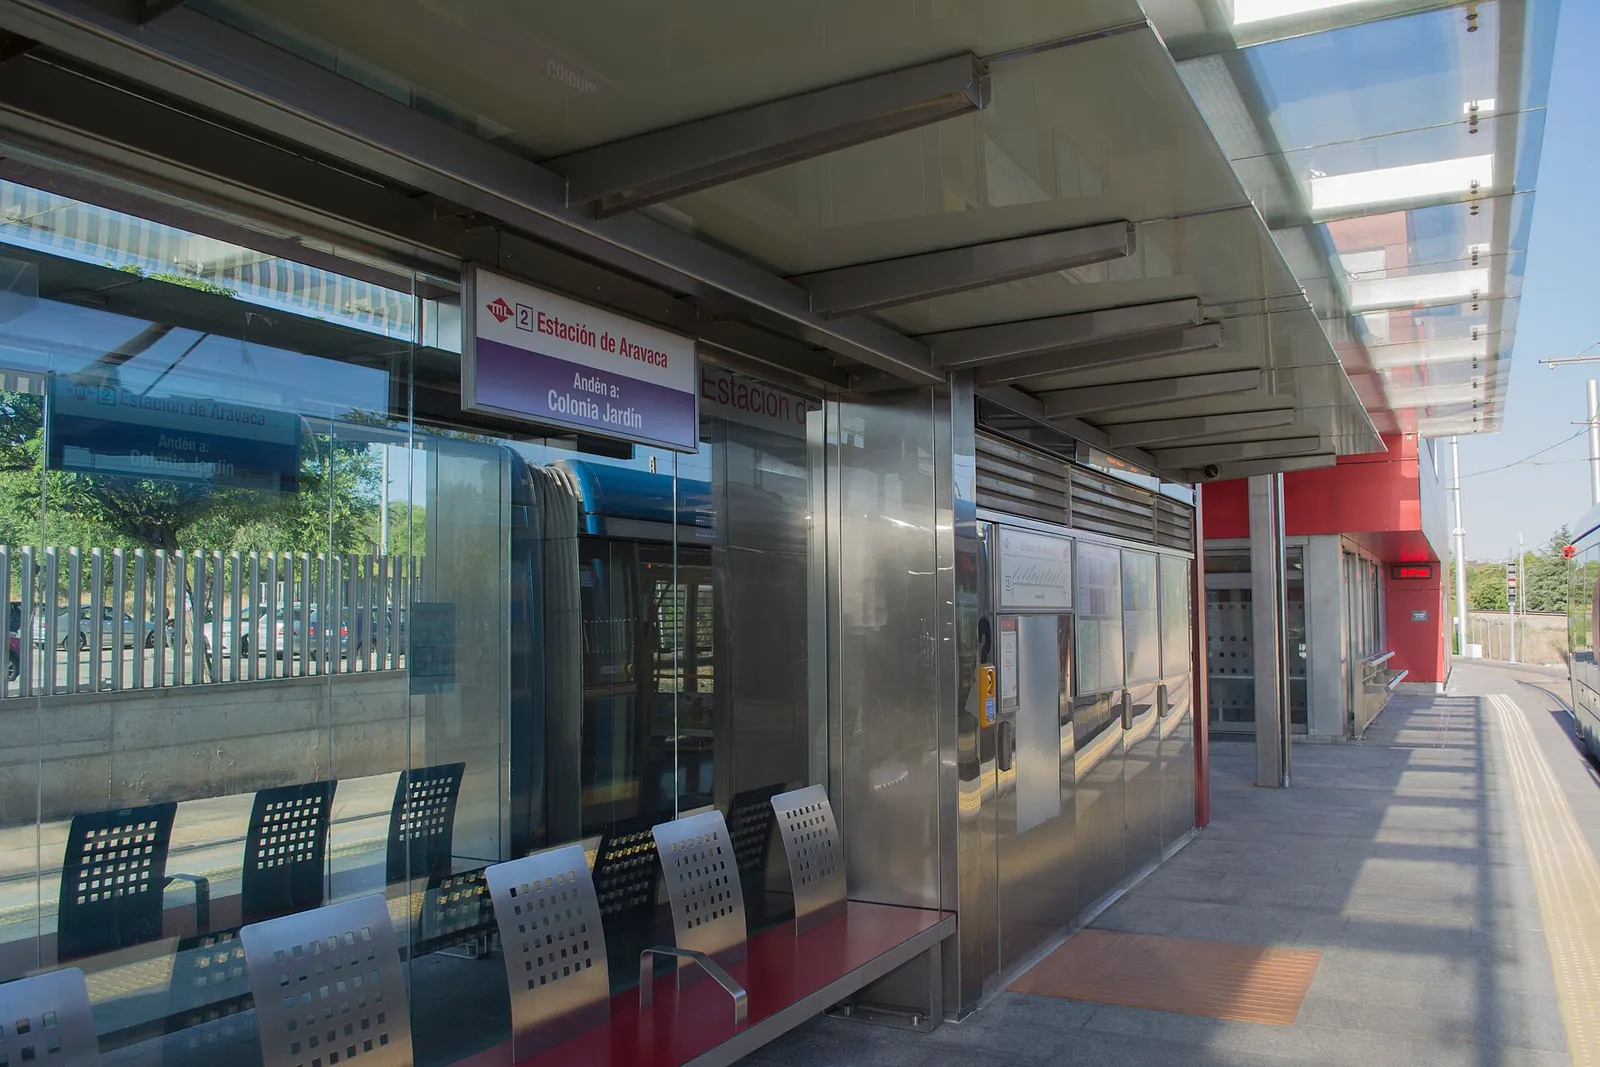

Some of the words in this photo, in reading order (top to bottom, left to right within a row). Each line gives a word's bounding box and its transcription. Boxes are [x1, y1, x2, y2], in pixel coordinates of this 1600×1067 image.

[520, 309, 529, 326] 2
[537, 311, 596, 348] Estación
[600, 331, 616, 353] de
[619, 336, 668, 368] Aravaca
[573, 372, 607, 396] Andén
[610, 384, 620, 399] a:
[189, 400, 206, 418] de
[210, 403, 266, 426] Aravaca
[547, 389, 599, 421] Colonia
[602, 402, 642, 429] Jardín
[157, 433, 196, 452] Andén
[198, 441, 210, 453] a:
[129, 449, 186, 471] Colonia
